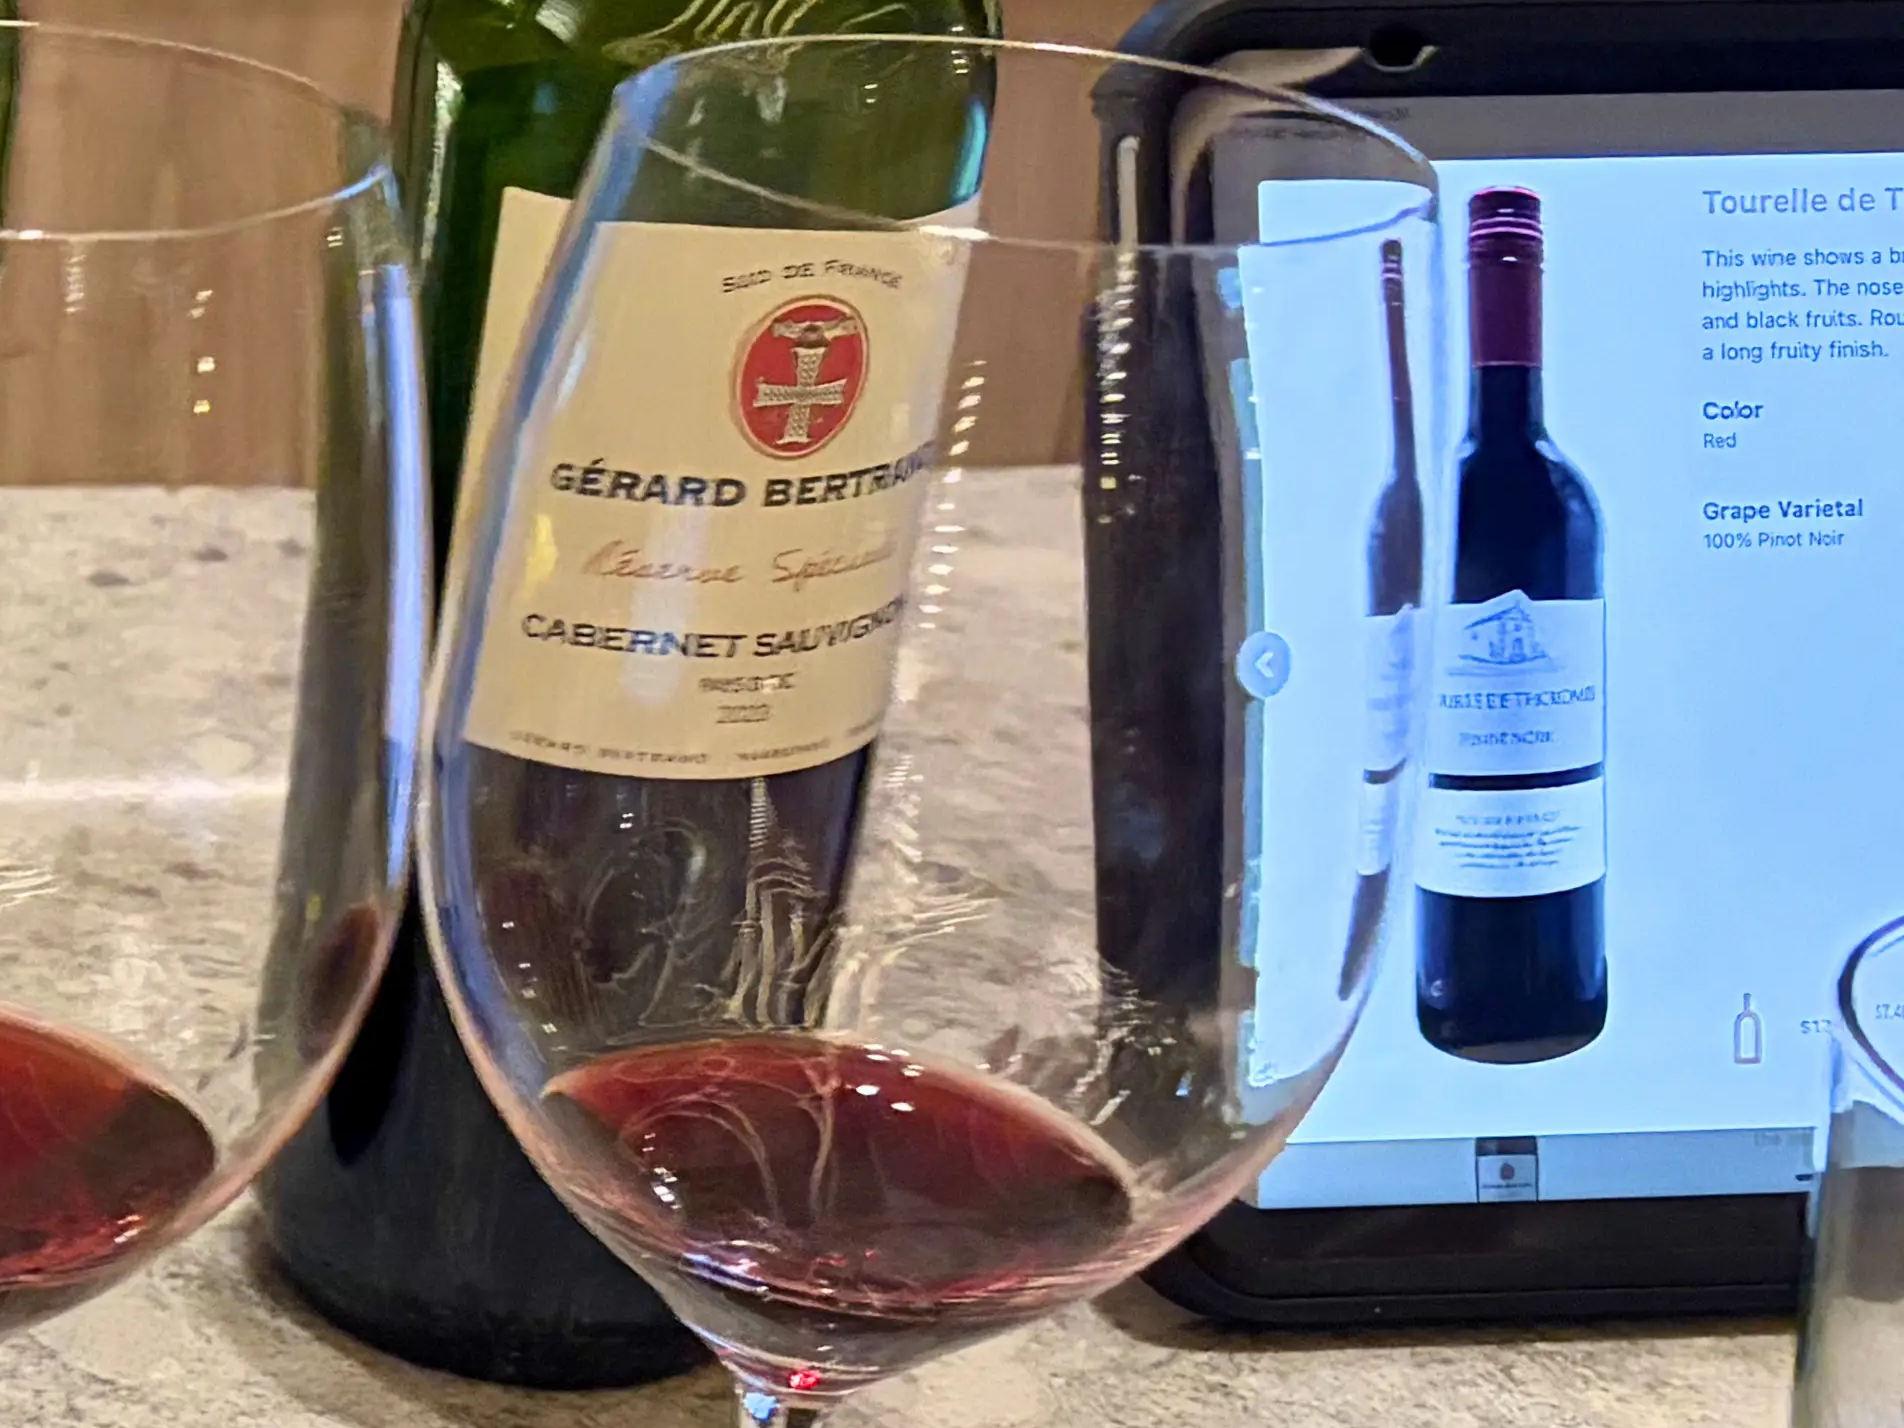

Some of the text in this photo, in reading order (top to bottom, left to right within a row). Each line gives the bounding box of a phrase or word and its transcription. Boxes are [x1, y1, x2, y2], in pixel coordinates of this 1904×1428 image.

[1702, 187, 1828, 214] Tourelle
[1838, 187, 1876, 212] de
[1701, 249, 1744, 267] This
[1751, 249, 1797, 267] wine
[1803, 248, 1865, 266] shows
[1871, 251, 1882, 265] a
[782, 262, 816, 279] DE
[1701, 278, 1904, 302] highlights. The nose
[1701, 312, 1739, 330] and
[1746, 310, 1799, 329] black
[1806, 310, 1863, 328] fruits.
[1702, 340, 1890, 364] a long fruity finish.
[1702, 400, 1764, 420] Color
[1703, 432, 1737, 449] Red
[550, 458, 748, 508] GÉRARD
[1702, 498, 1864, 523] Grape Varietal
[1703, 530, 1845, 550] 100% Pinot Noir
[521, 613, 748, 659] CABERNET
